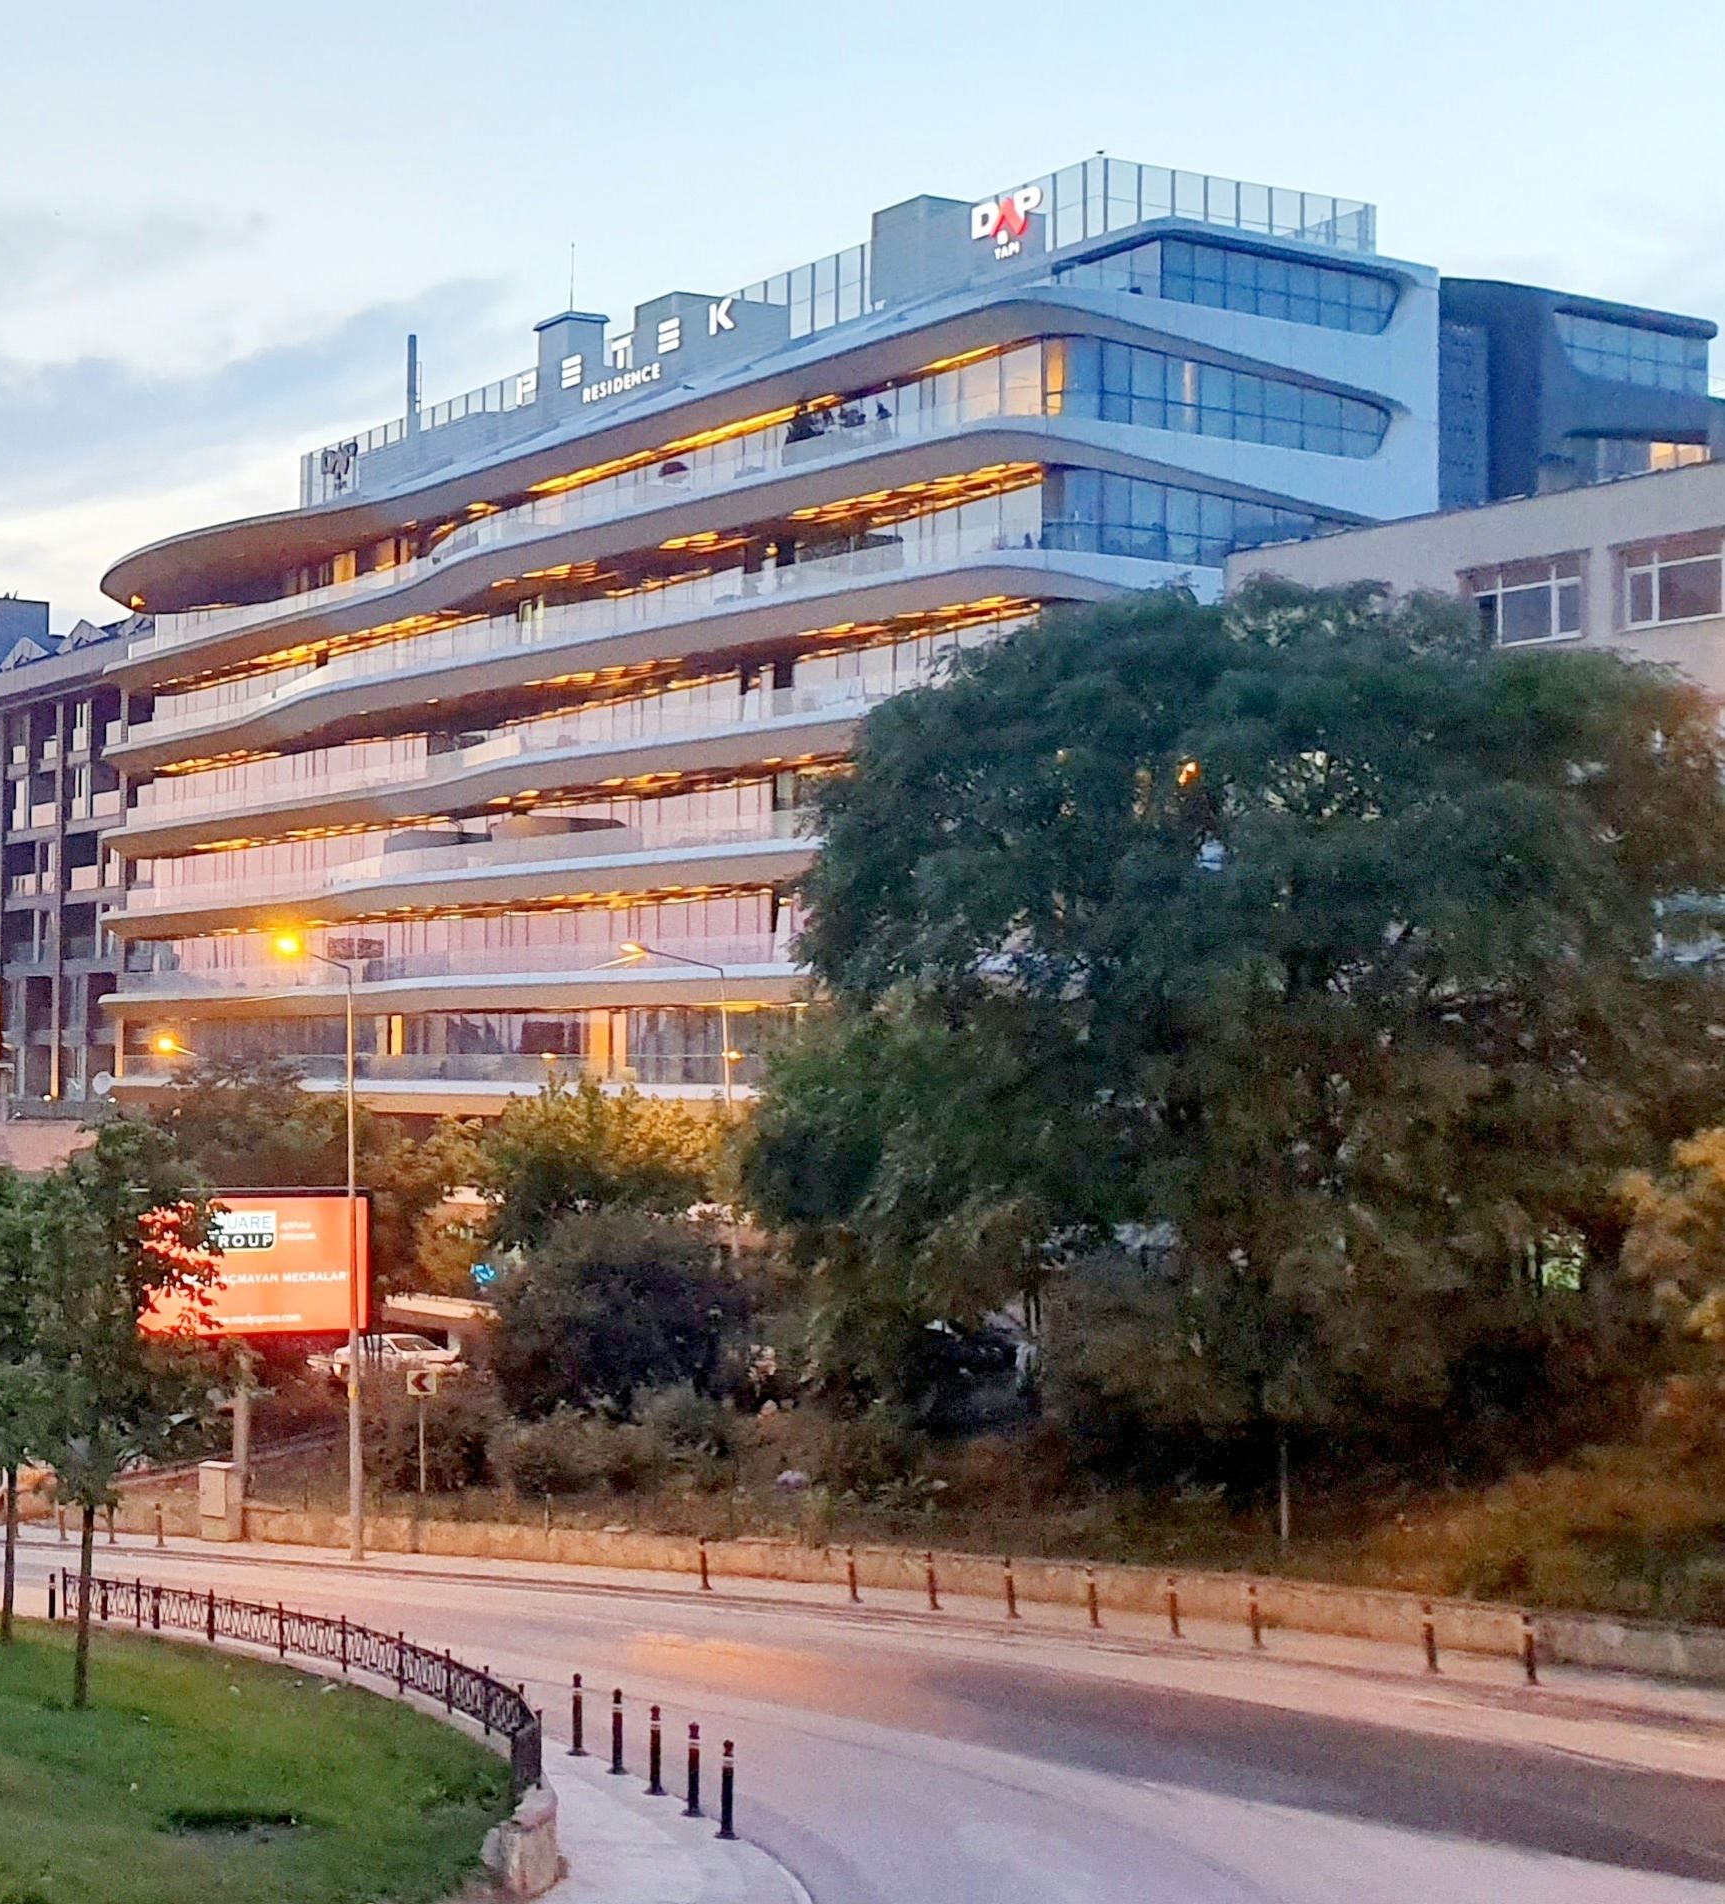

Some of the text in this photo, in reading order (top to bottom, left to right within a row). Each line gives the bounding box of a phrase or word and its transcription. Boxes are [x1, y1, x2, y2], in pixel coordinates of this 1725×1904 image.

[971, 186, 1043, 239] DAP
[516, 298, 735, 407] PETEK
[582, 361, 662, 404] RESIDENCE
